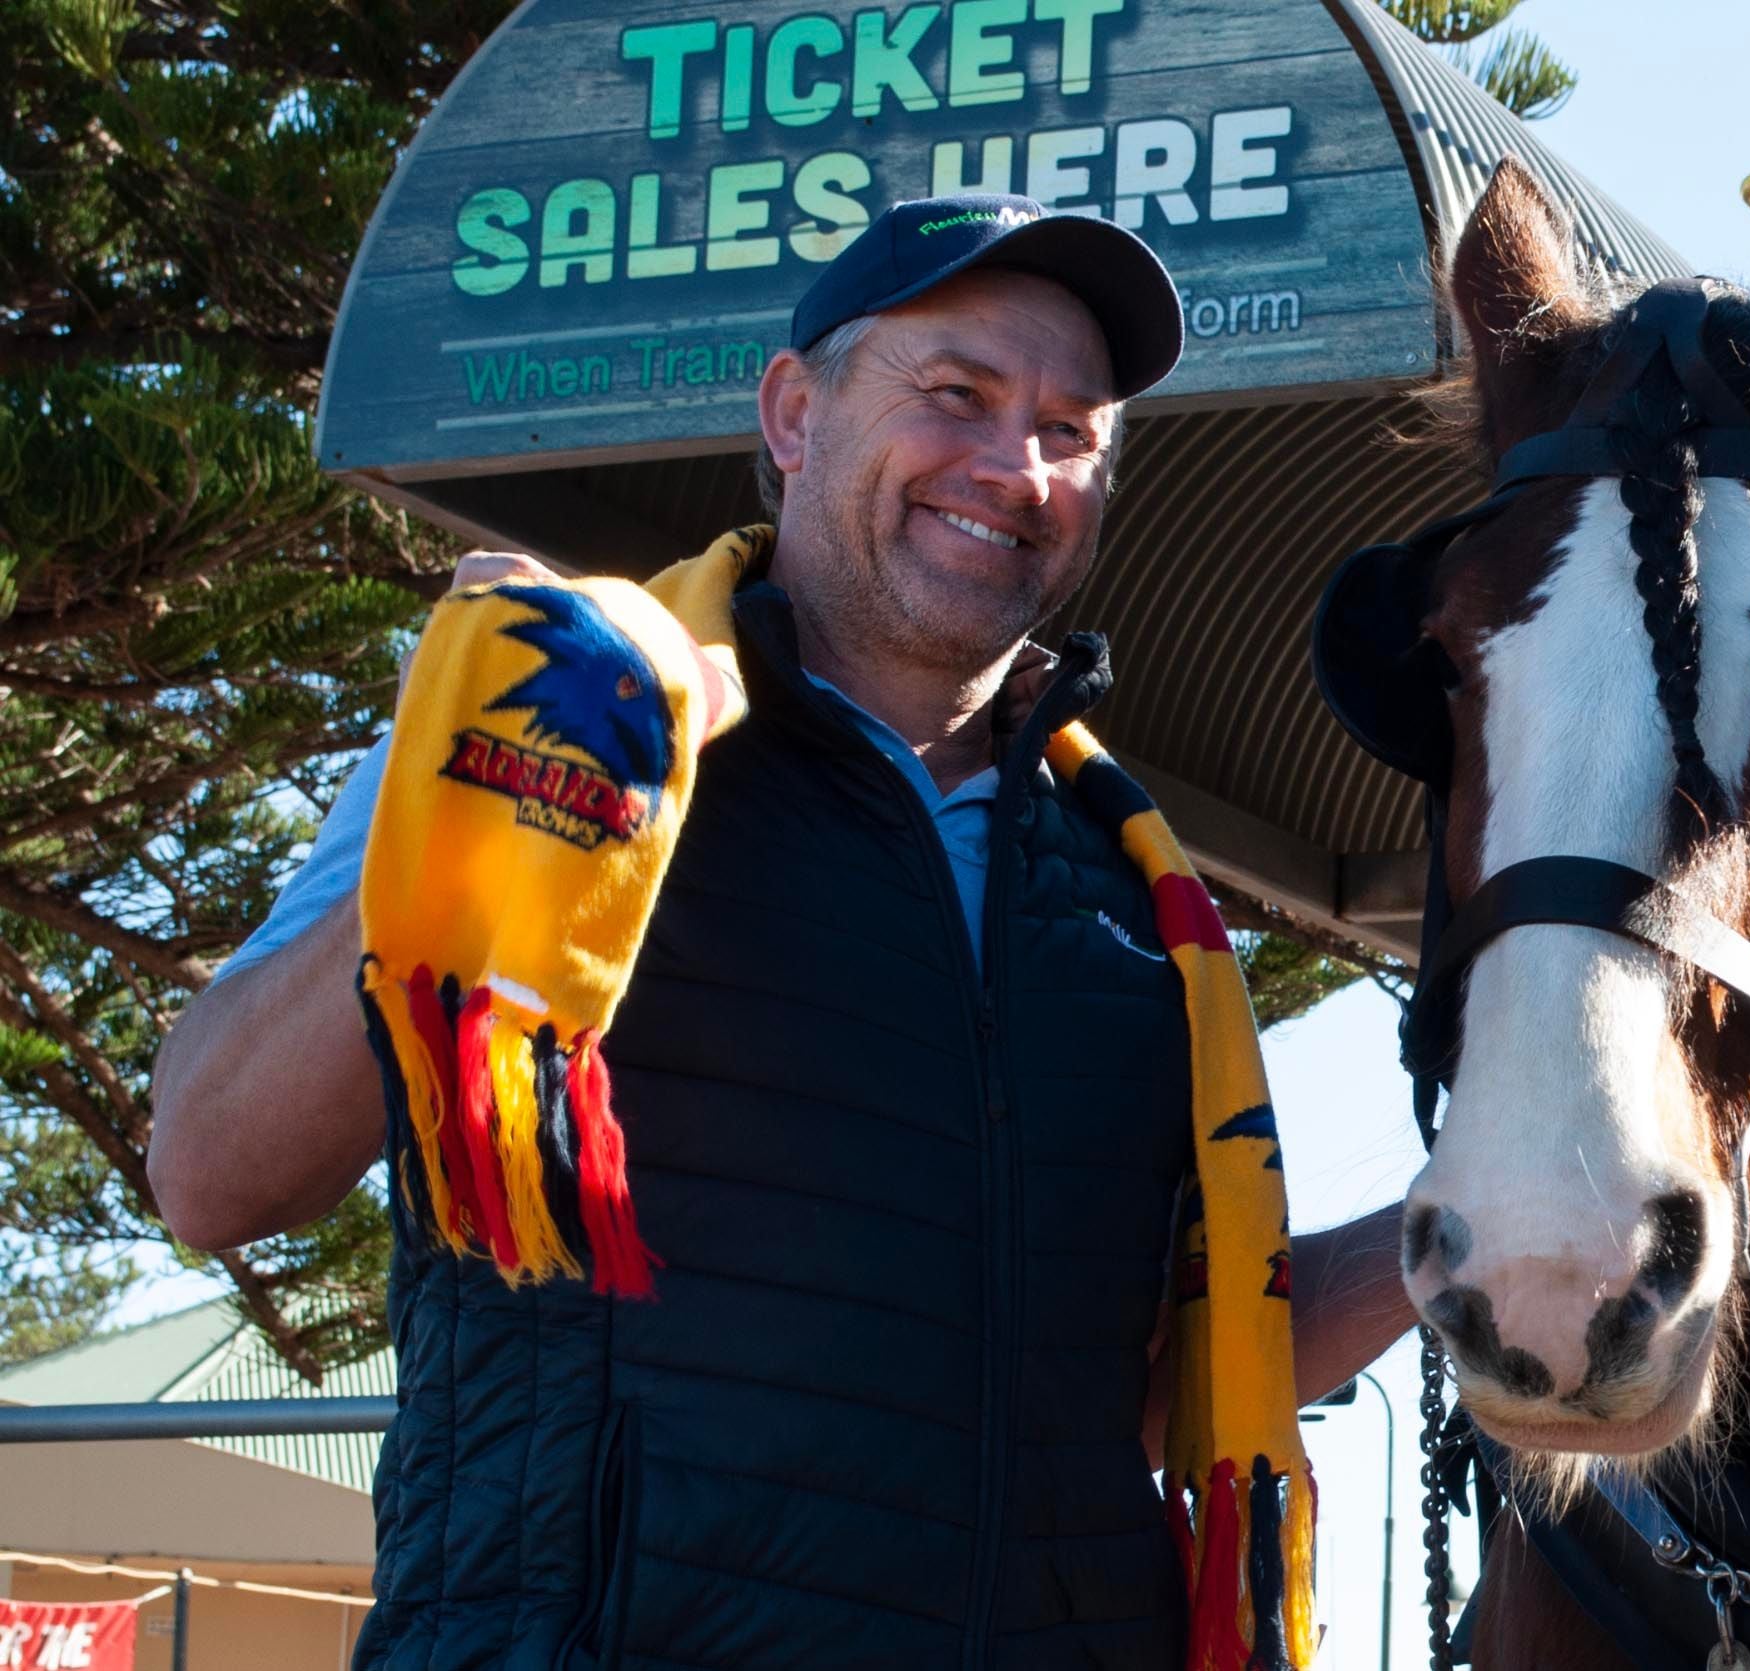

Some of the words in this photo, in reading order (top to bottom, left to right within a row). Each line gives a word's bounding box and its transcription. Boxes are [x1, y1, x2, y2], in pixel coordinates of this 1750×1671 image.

[620, 0, 1124, 139] TICKET
[451, 151, 872, 296] SALES
[932, 106, 1292, 230] HERE
[463, 351, 613, 404] When
[630, 338, 763, 390] Tram
